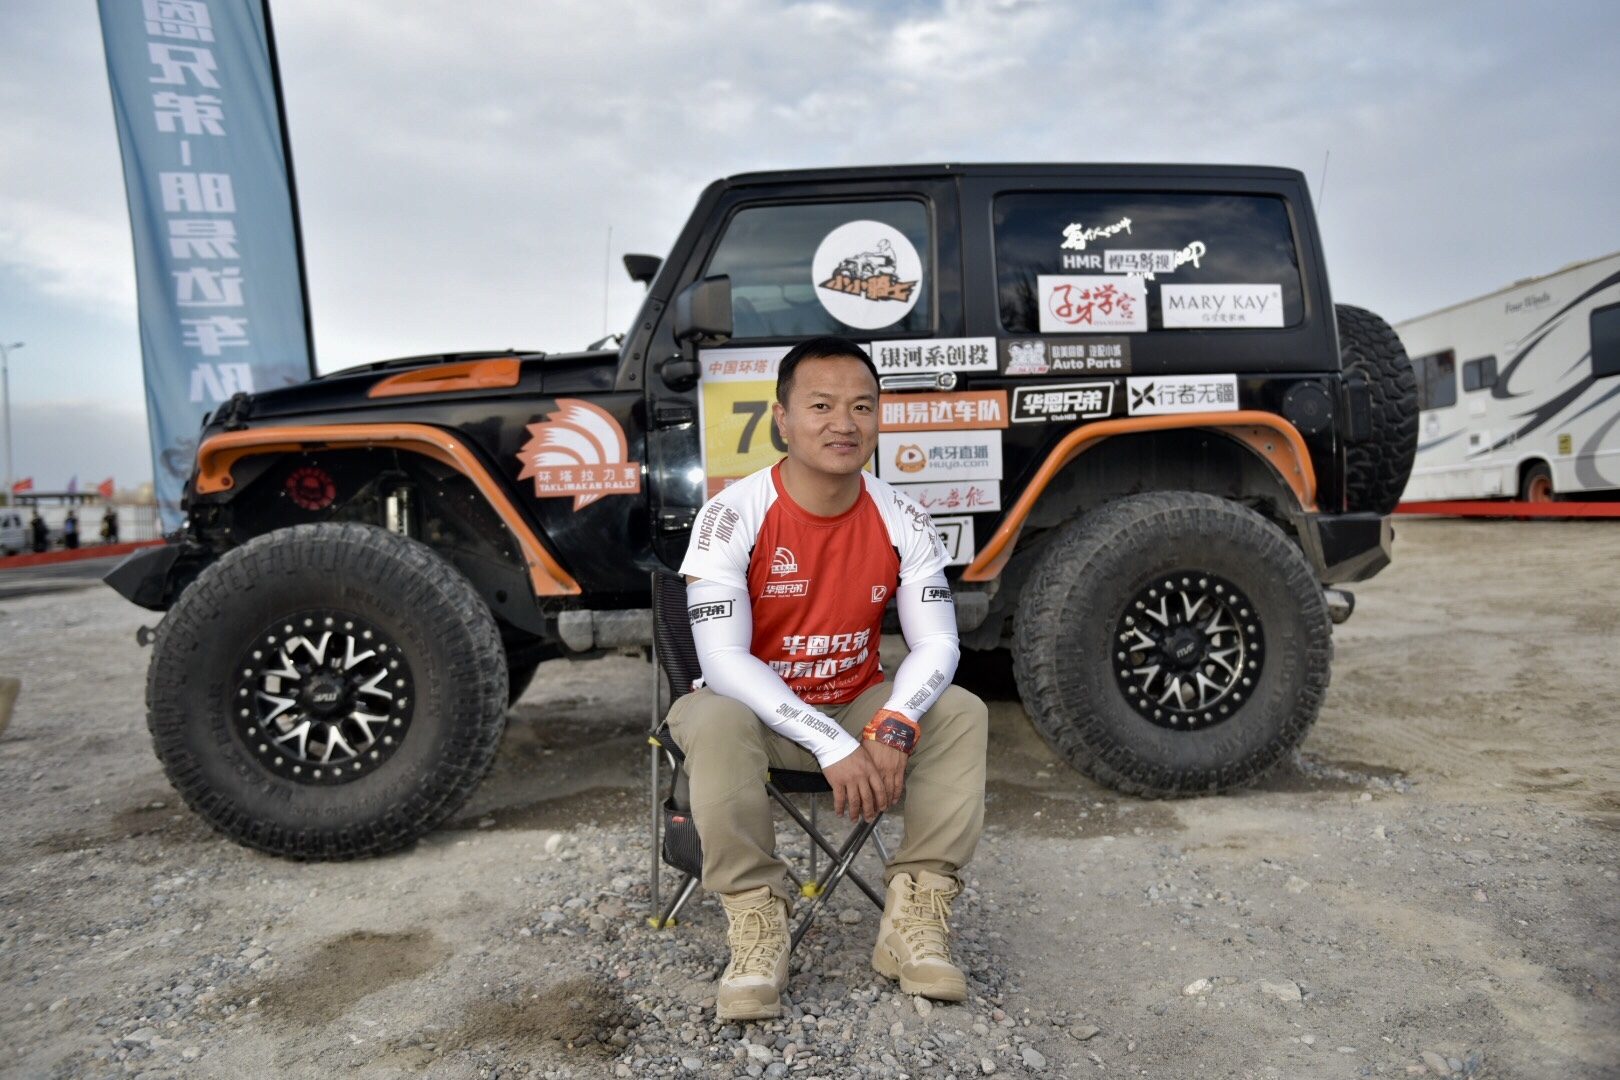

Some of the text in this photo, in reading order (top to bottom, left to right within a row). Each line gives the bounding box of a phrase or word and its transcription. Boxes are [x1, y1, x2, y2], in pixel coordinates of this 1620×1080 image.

[1063, 255, 1102, 269] HMR
[1108, 253, 1170, 272] 悍马影视
[1168, 295, 1269, 313] MARY KAY
[880, 344, 989, 368] 银河系创投
[1052, 358, 1085, 370] Auto
[1086, 357, 1122, 369] Parts
[1022, 389, 1103, 415] 华恩兄弟
[1157, 383, 1235, 405] 行者无疆
[882, 399, 1001, 424] 明易达车队
[929, 445, 988, 460] 虎牙直播
[605, 481, 637, 490] RALLY
[715, 505, 739, 543] HIKING
[782, 627, 871, 656] 华恩兄弟
